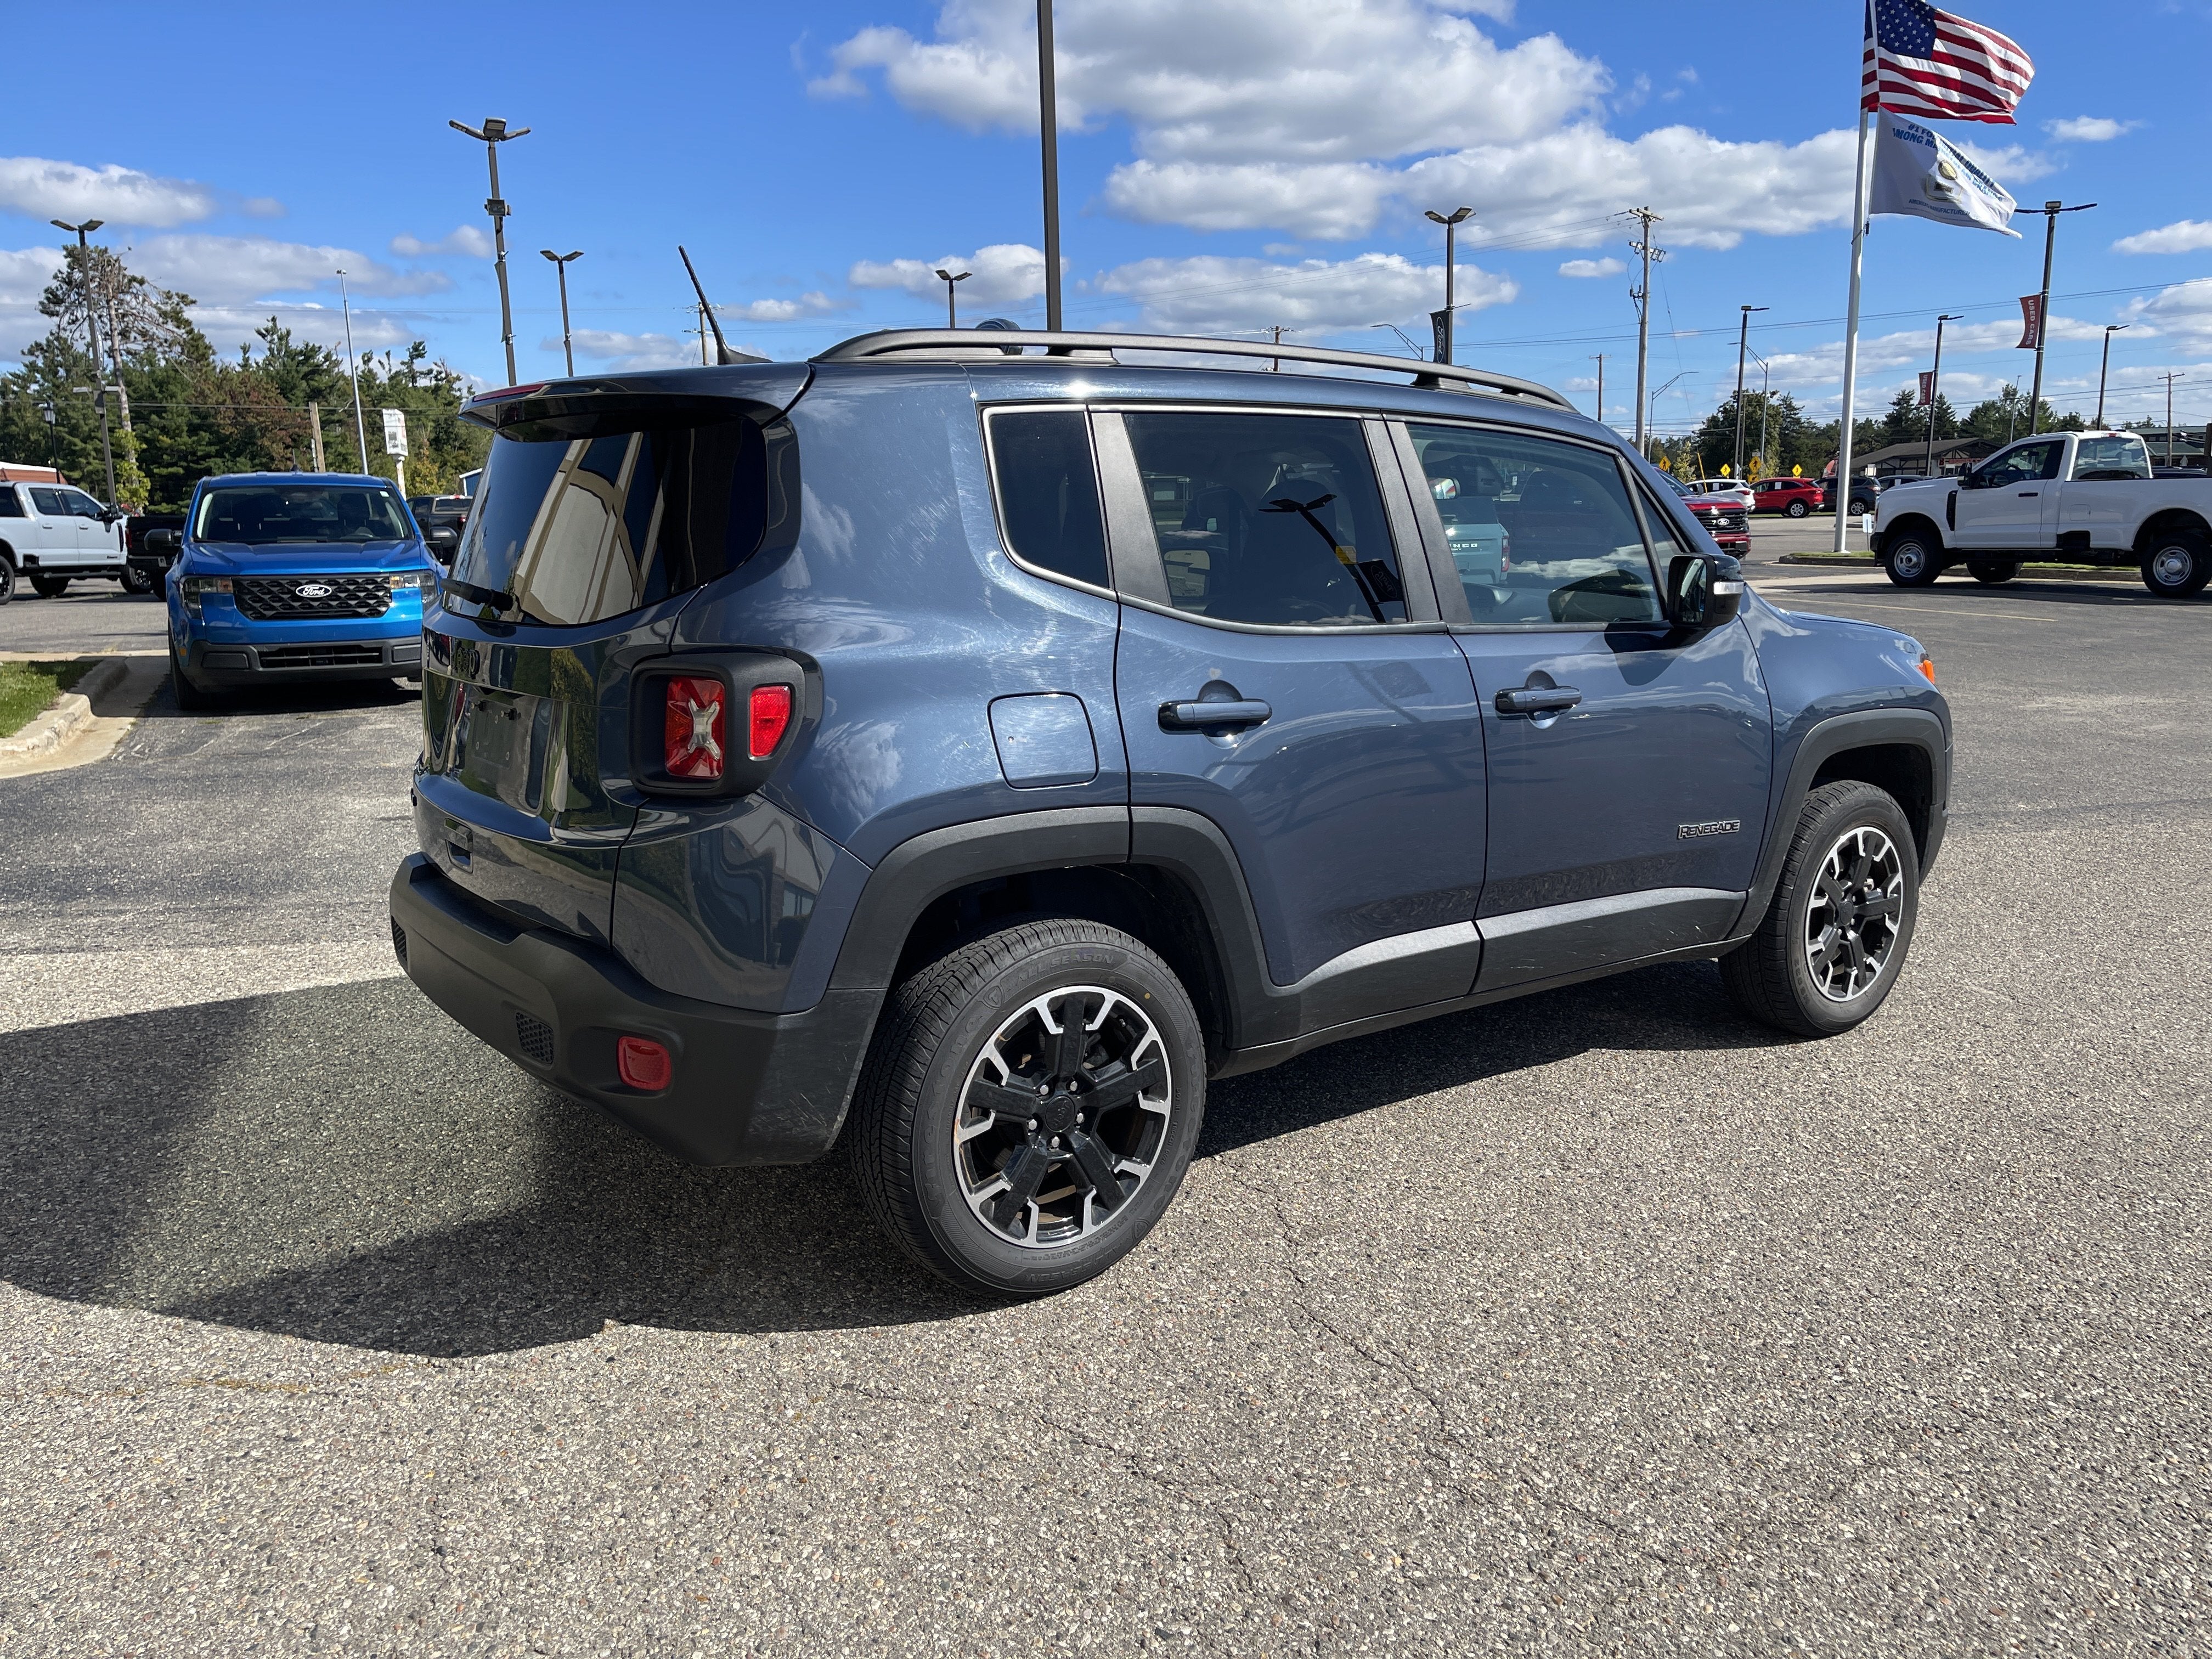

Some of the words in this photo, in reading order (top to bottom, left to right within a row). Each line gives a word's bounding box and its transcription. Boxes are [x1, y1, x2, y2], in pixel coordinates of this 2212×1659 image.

[1908, 123, 1920, 133] #1
[1921, 128, 1936, 139] FO
[2028, 300, 2036, 321] USED
[1437, 325, 1445, 355] Ford
[2025, 324, 2035, 345] CARS
[1677, 820, 1741, 839] RENEGADE
[1050, 953, 1115, 968] SEASON
